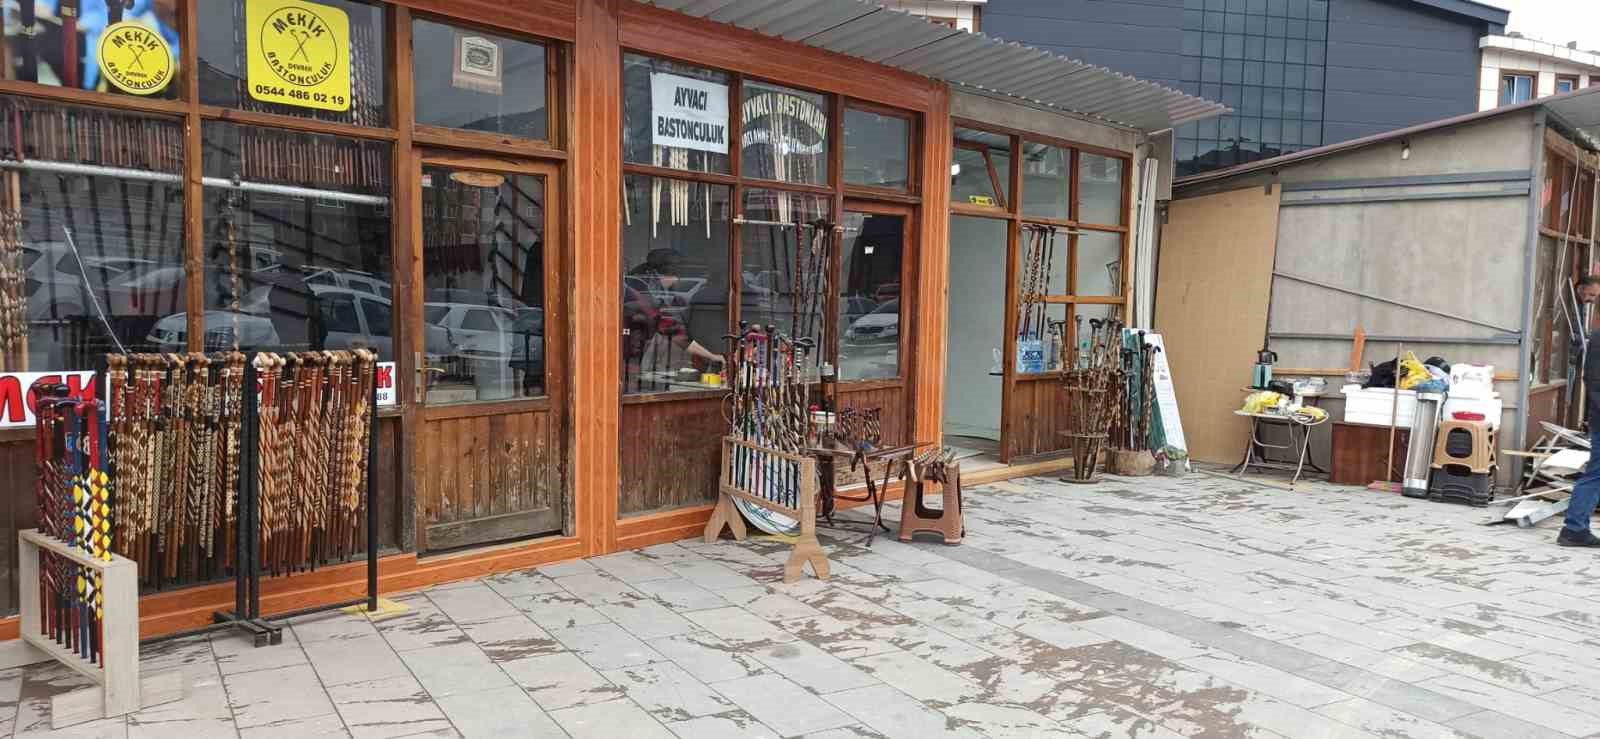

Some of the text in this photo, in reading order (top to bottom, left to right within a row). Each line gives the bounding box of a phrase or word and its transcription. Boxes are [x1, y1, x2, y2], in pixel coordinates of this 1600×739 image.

[107, 62, 165, 89] BASTONCULUK
[267, 51, 332, 85] BASTONCULUK
[255, 84, 345, 106] 0544 486 02 19
[673, 85, 708, 112] AYVACI
[742, 92, 773, 125] AYVACI
[657, 115, 725, 145] BASTONCULUK
